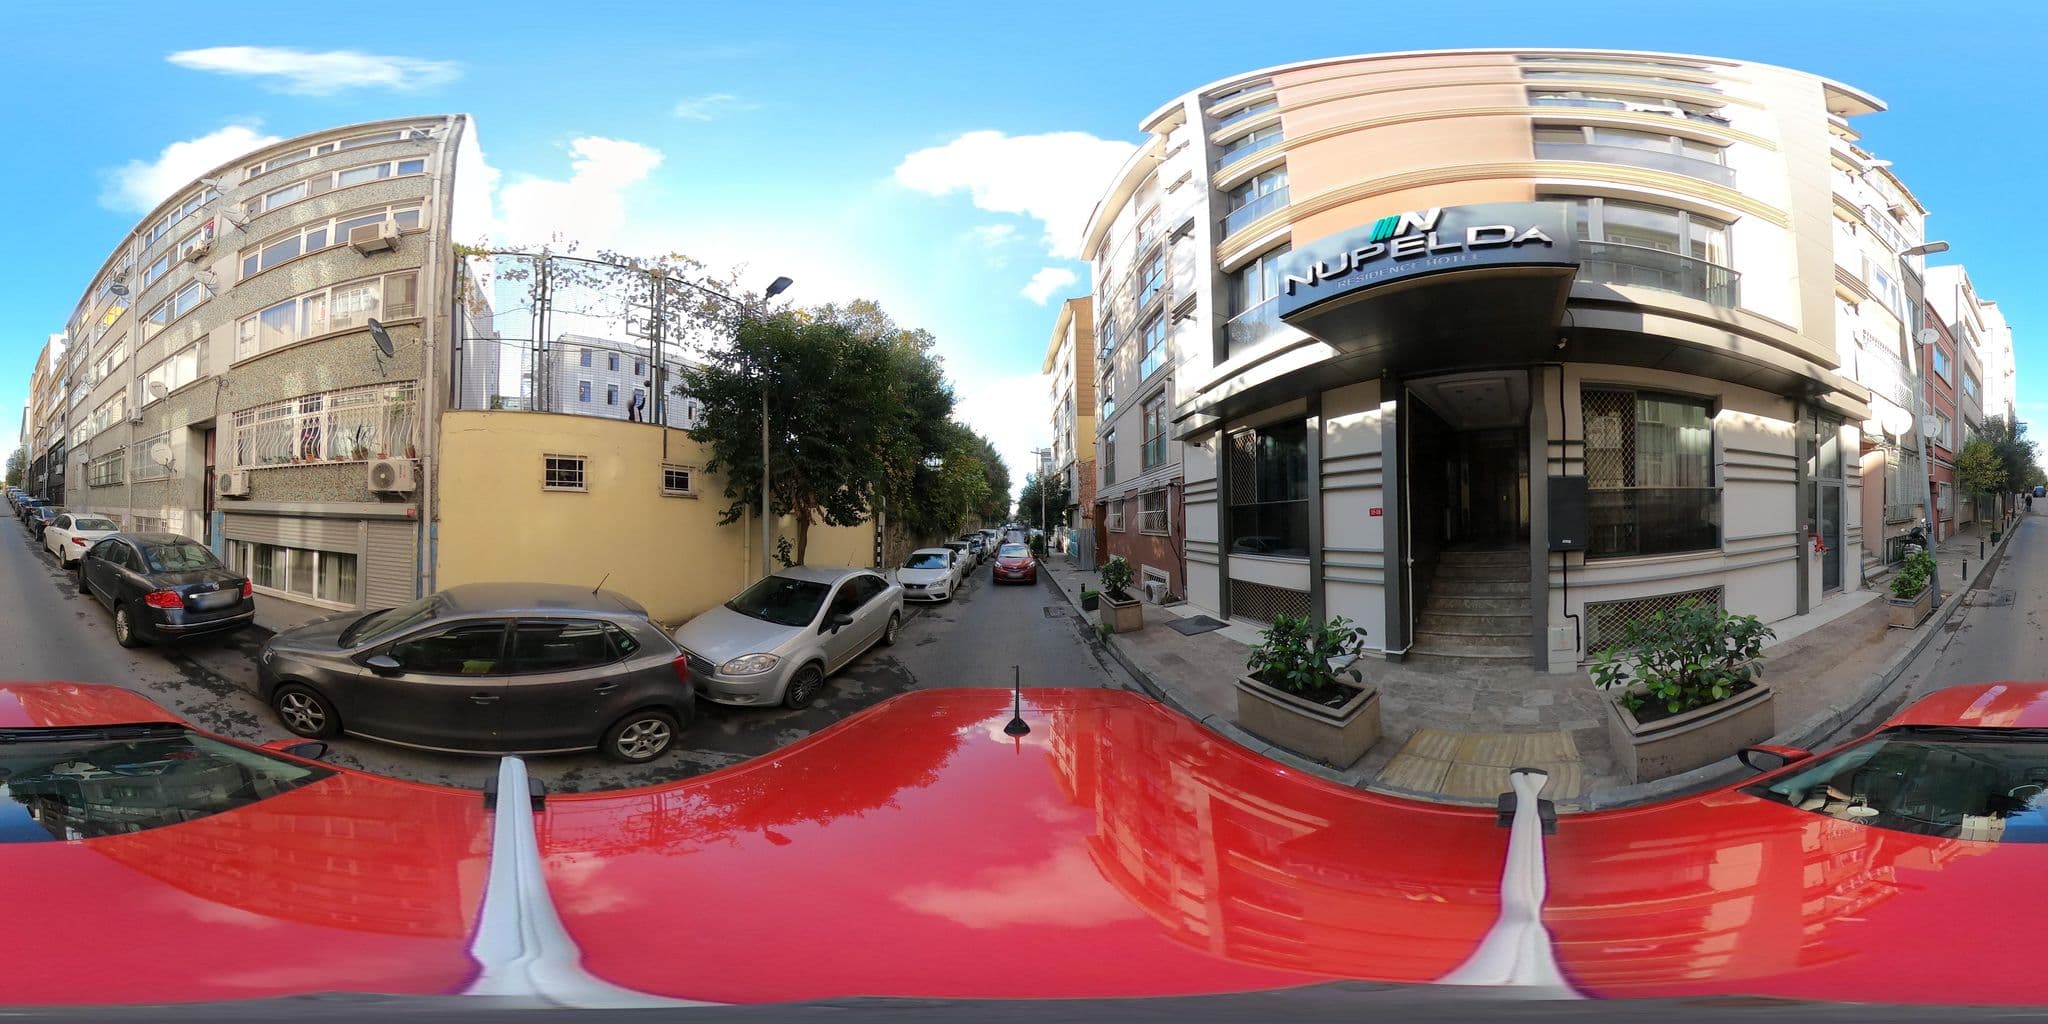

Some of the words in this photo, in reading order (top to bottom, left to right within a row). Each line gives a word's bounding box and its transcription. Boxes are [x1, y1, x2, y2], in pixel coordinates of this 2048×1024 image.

[1284, 225, 1553, 295] NUPELDA
[1336, 261, 1419, 289] RESIDENCE
[1425, 253, 1482, 267] HOTEL
